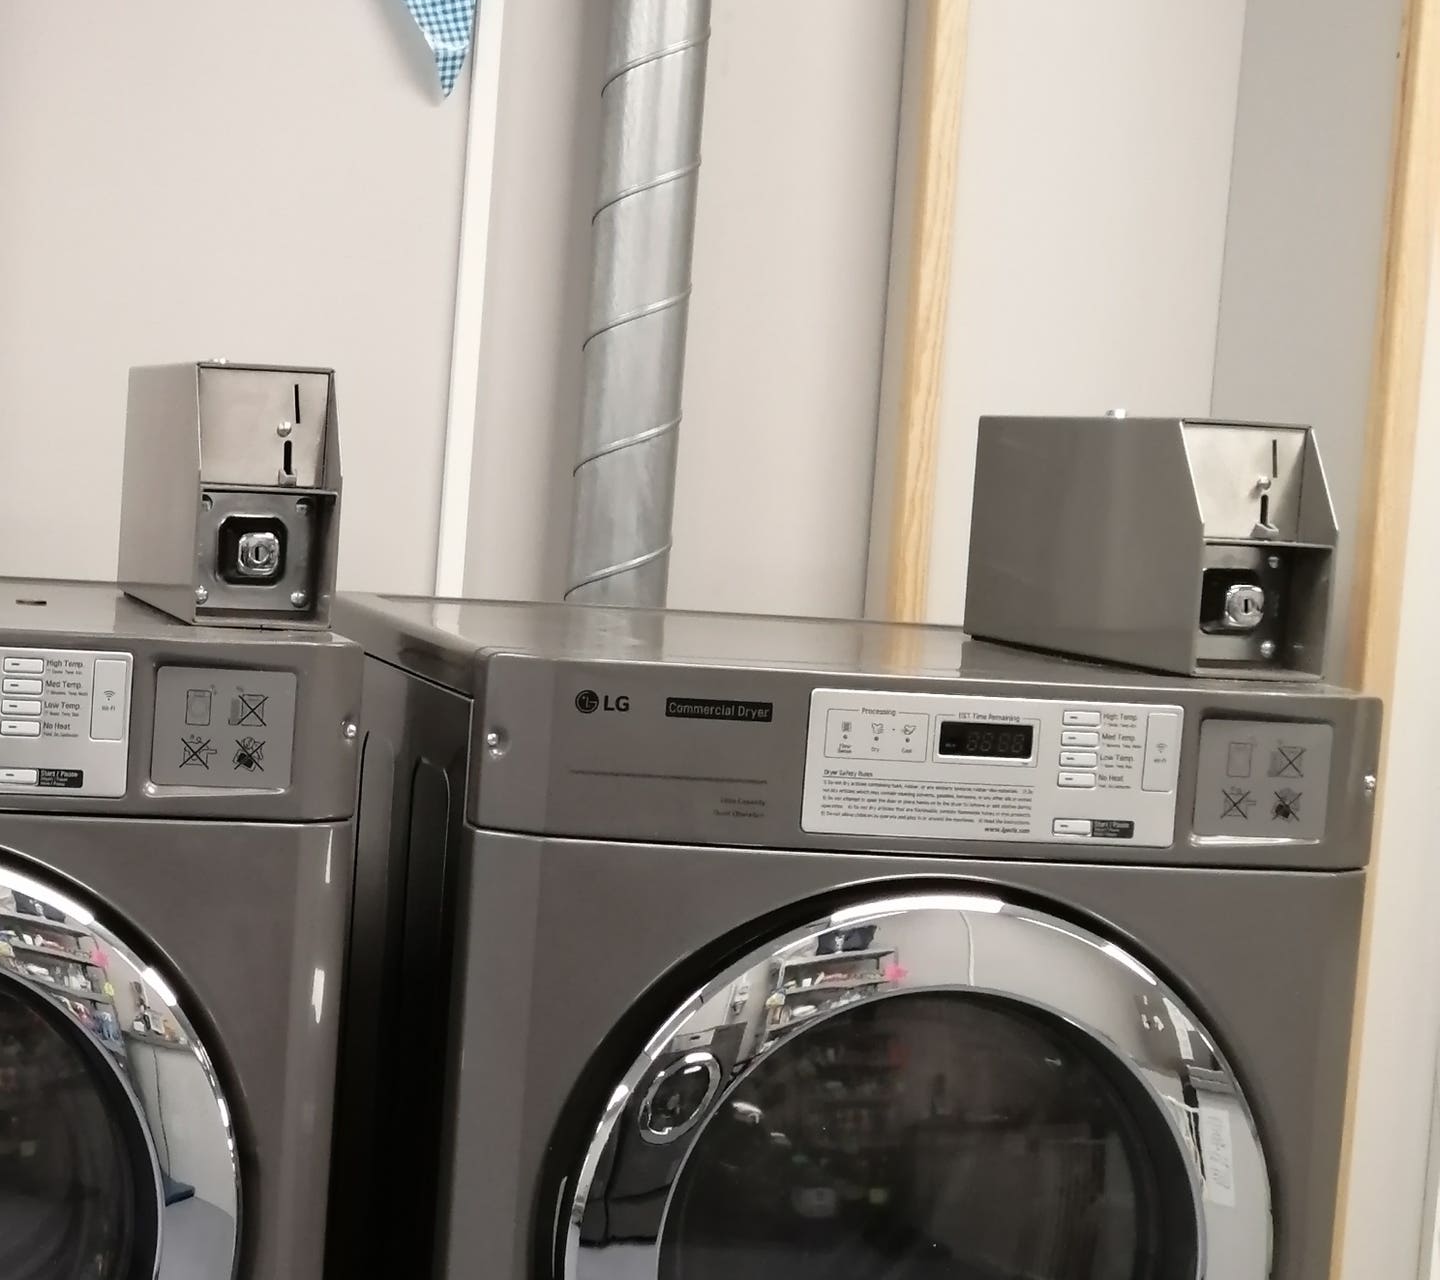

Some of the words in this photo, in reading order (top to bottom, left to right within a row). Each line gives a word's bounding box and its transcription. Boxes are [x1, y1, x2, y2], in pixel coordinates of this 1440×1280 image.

[603, 695, 630, 712] LG
[668, 701, 735, 717] Commercial
[738, 704, 770, 719] Dryer
